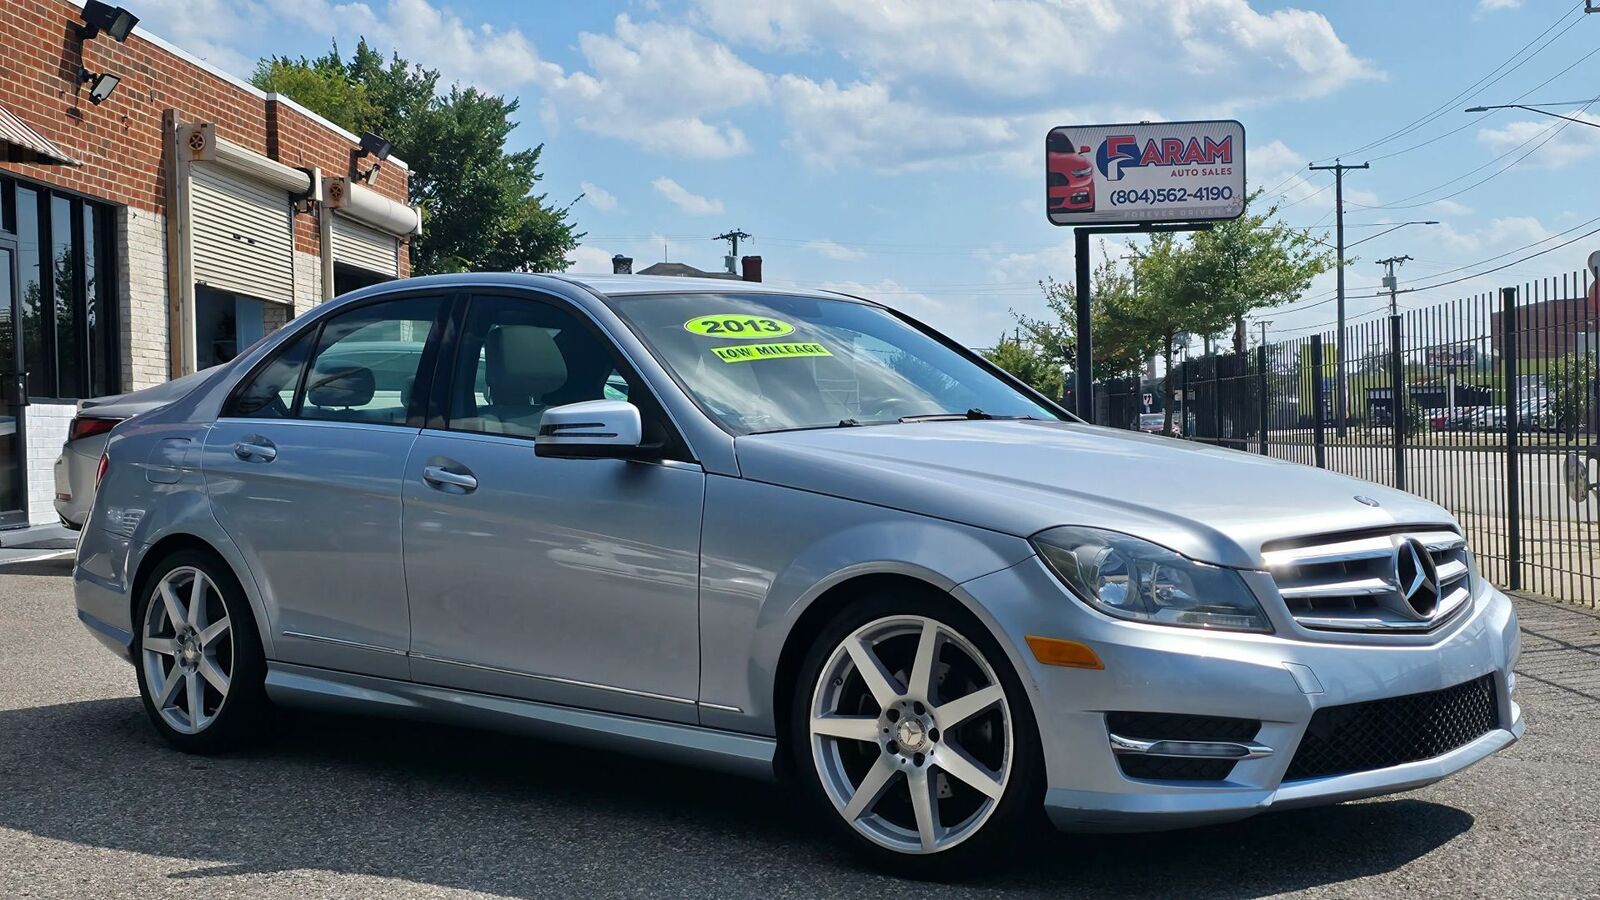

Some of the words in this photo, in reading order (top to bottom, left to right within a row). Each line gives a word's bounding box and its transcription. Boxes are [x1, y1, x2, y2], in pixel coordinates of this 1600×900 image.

[1171, 168, 1198, 177] AUTO
[1202, 167, 1232, 176] SALES
[1110, 186, 1232, 205] (804)562-4190
[1124, 208, 1174, 217] FOREVER
[1180, 207, 1222, 216] DRIVEN
[702, 319, 780, 333] 2013
[718, 347, 751, 358] LOW
[756, 345, 825, 355] MILEAGE
